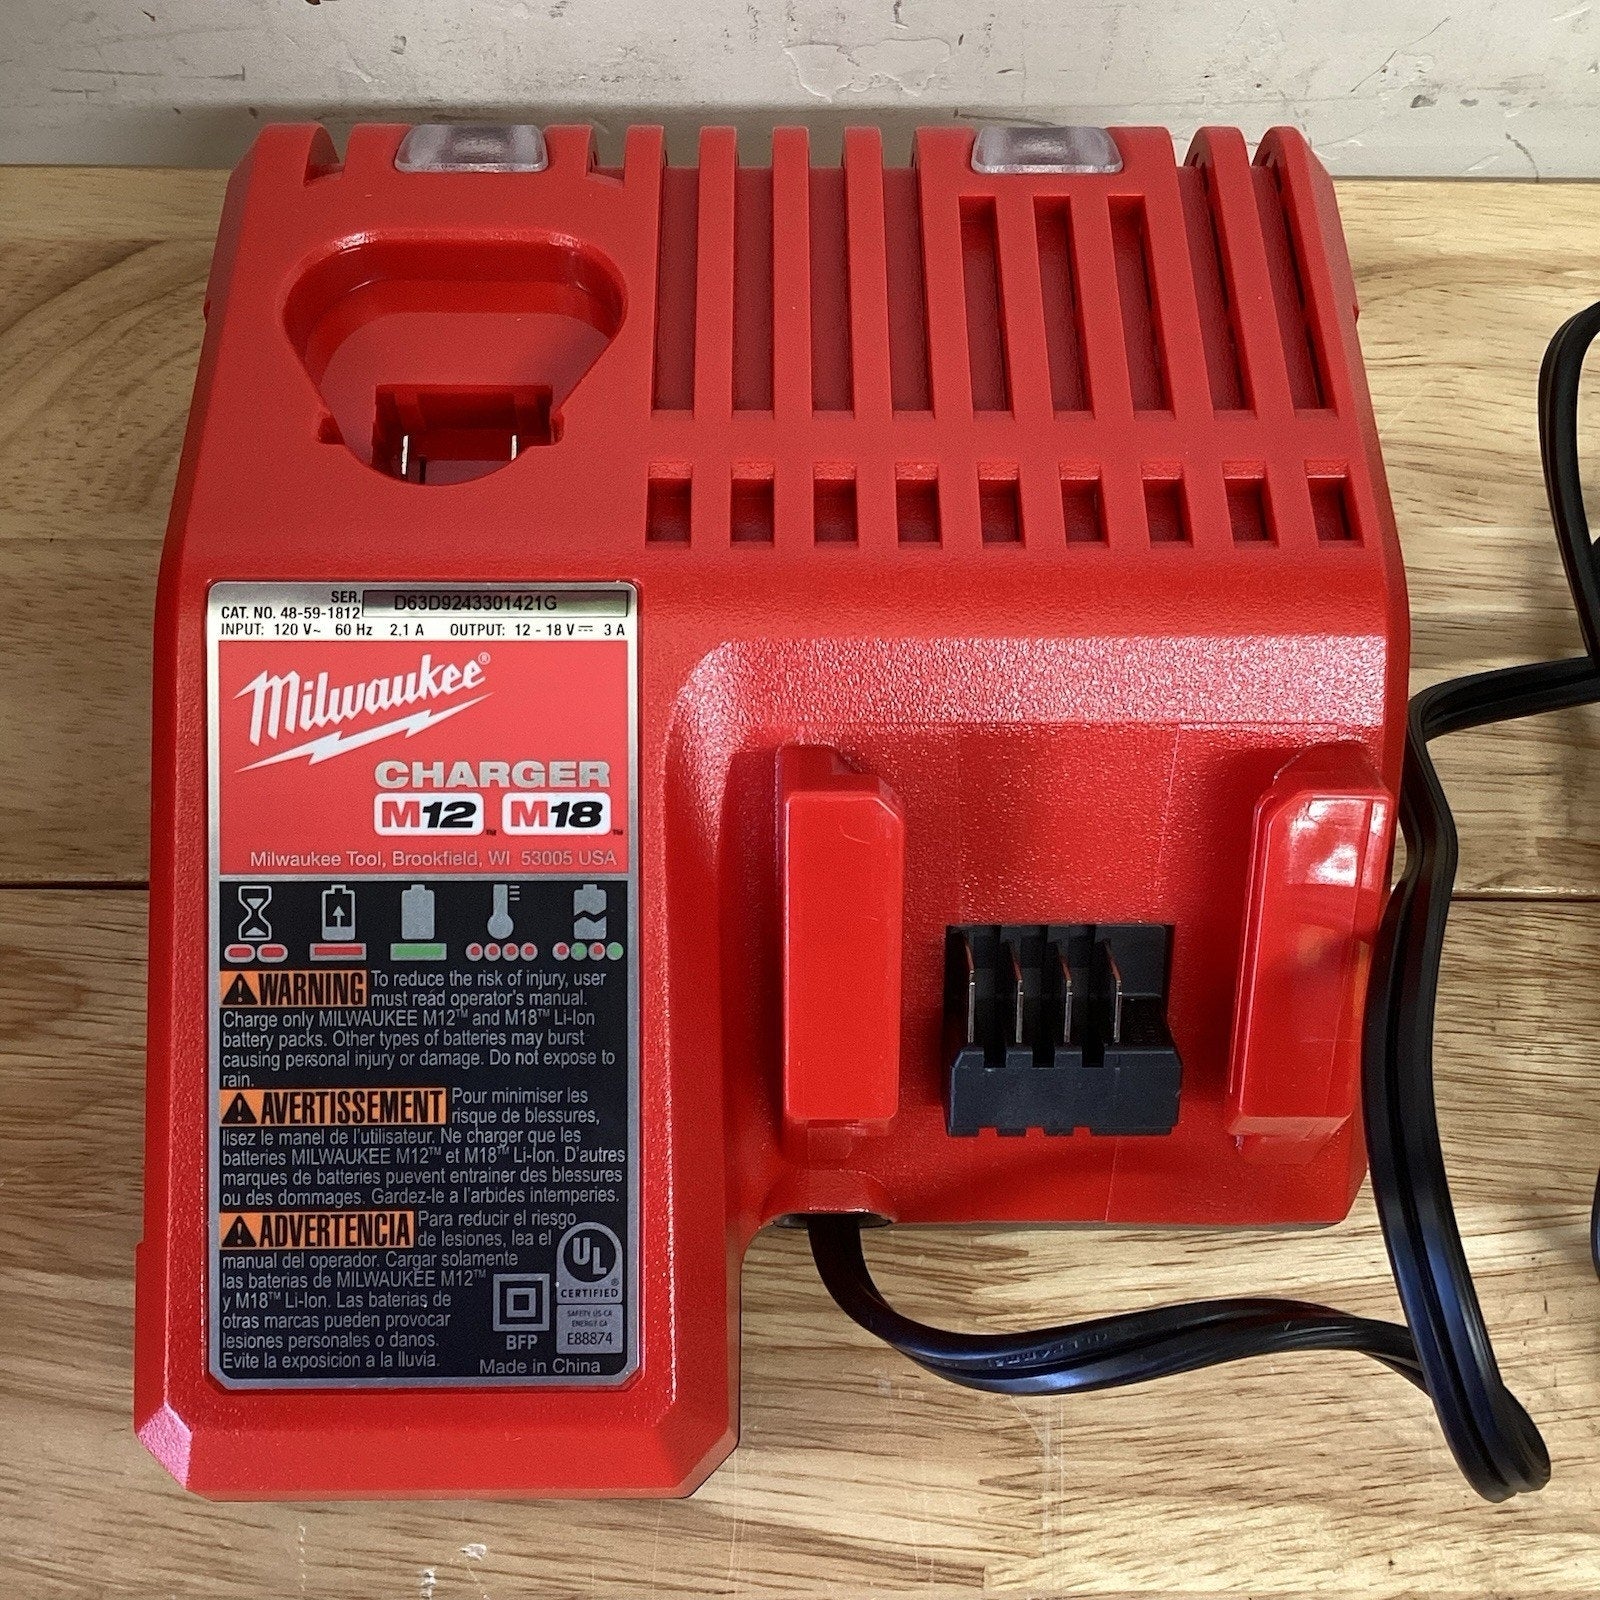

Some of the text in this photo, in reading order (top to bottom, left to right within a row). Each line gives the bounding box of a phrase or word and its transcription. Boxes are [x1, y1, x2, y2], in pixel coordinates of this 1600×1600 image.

[331, 591, 361, 603] SER.
[394, 596, 557, 610] D63D9243301421G
[221, 607, 360, 619] CAT. NO. 48-59-1812
[221, 624, 264, 635] INPUT:
[274, 624, 298, 635] 120
[335, 624, 351, 635] 60
[356, 624, 372, 635] Hz
[415, 624, 424, 635] A
[450, 624, 505, 635] OUTPUT:
[515, 624, 530, 635] 12
[547, 624, 561, 635] 18
[604, 624, 611, 635] 3
[617, 624, 625, 635] A
[374, 761, 610, 788] CHARGER
[250, 851, 617, 868] Milwaukee Tool, Brookfield, WI 53005 USA
[258, 973, 364, 1005] WARNING
[371, 970, 606, 990] To reduce the risk of injury, user
[371, 990, 587, 1009] must read operator's manual.
[223, 1011, 277, 1031] Charge
[283, 1011, 314, 1031] only
[319, 1011, 417, 1026] MILWAUKEE
[472, 1010, 499, 1025] and
[555, 1010, 595, 1025] Li-Ion
[223, 1030, 585, 1051] battery packs. Other types of batteries may burst
[223, 1050, 615, 1070] causing personal injury or damage. Do not expose to
[223, 1072, 254, 1087] rain.
[452, 1087, 588, 1103] Pour minimiser les
[261, 1091, 443, 1122] AVERTISSEMENT
[452, 1108, 599, 1127] risque de blessures,
[223, 1130, 256, 1146] lisez
[261, 1130, 273, 1146] le
[279, 1130, 324, 1145] manel
[330, 1129, 348, 1145] de
[441, 1128, 461, 1144] Ne
[467, 1127, 523, 1147] charger
[528, 1130, 556, 1146] que
[561, 1127, 581, 1142] les
[223, 1151, 286, 1166] batteries
[292, 1149, 391, 1165] MILWAUKEE
[446, 1148, 460, 1163] et
[514, 1147, 559, 1163] Li-Ion.
[564, 1146, 625, 1162] D'autres
[223, 1167, 622, 1189] marques de batteries puevent entrainer des blessures
[223, 1194, 240, 1206] ou
[246, 1190, 273, 1205] des
[278, 1190, 365, 1208] dommages.
[372, 1188, 444, 1203] Gardez-le
[450, 1191, 459, 1203] a
[530, 1186, 619, 1205] intemperies.
[418, 1210, 576, 1229] Para reducir el riesgo
[259, 1213, 411, 1247] ADVERTENCIA
[418, 1230, 551, 1248] de lesiones, lea el
[223, 1251, 518, 1272] manual del operador. Cargar solamente
[223, 1273, 243, 1288] las
[249, 1272, 308, 1288] baterias
[313, 1272, 331, 1287] de
[337, 1271, 435, 1287] MILWAUKEE
[223, 1297, 231, 1312] y
[285, 1293, 331, 1308] Li-Ion.
[337, 1292, 363, 1308] Las
[369, 1291, 427, 1307] baterias
[433, 1291, 451, 1306] de
[561, 1289, 618, 1297] CERTIFIED
[223, 1312, 450, 1331] otras marcas pueden provocar
[223, 1331, 439, 1350] lesiones personales o danos.
[506, 1336, 537, 1350] BFP
[568, 1333, 612, 1345] E88874
[223, 1351, 439, 1371] Evite la exposicion a la lluvia.
[480, 1358, 600, 1373] Made in China
